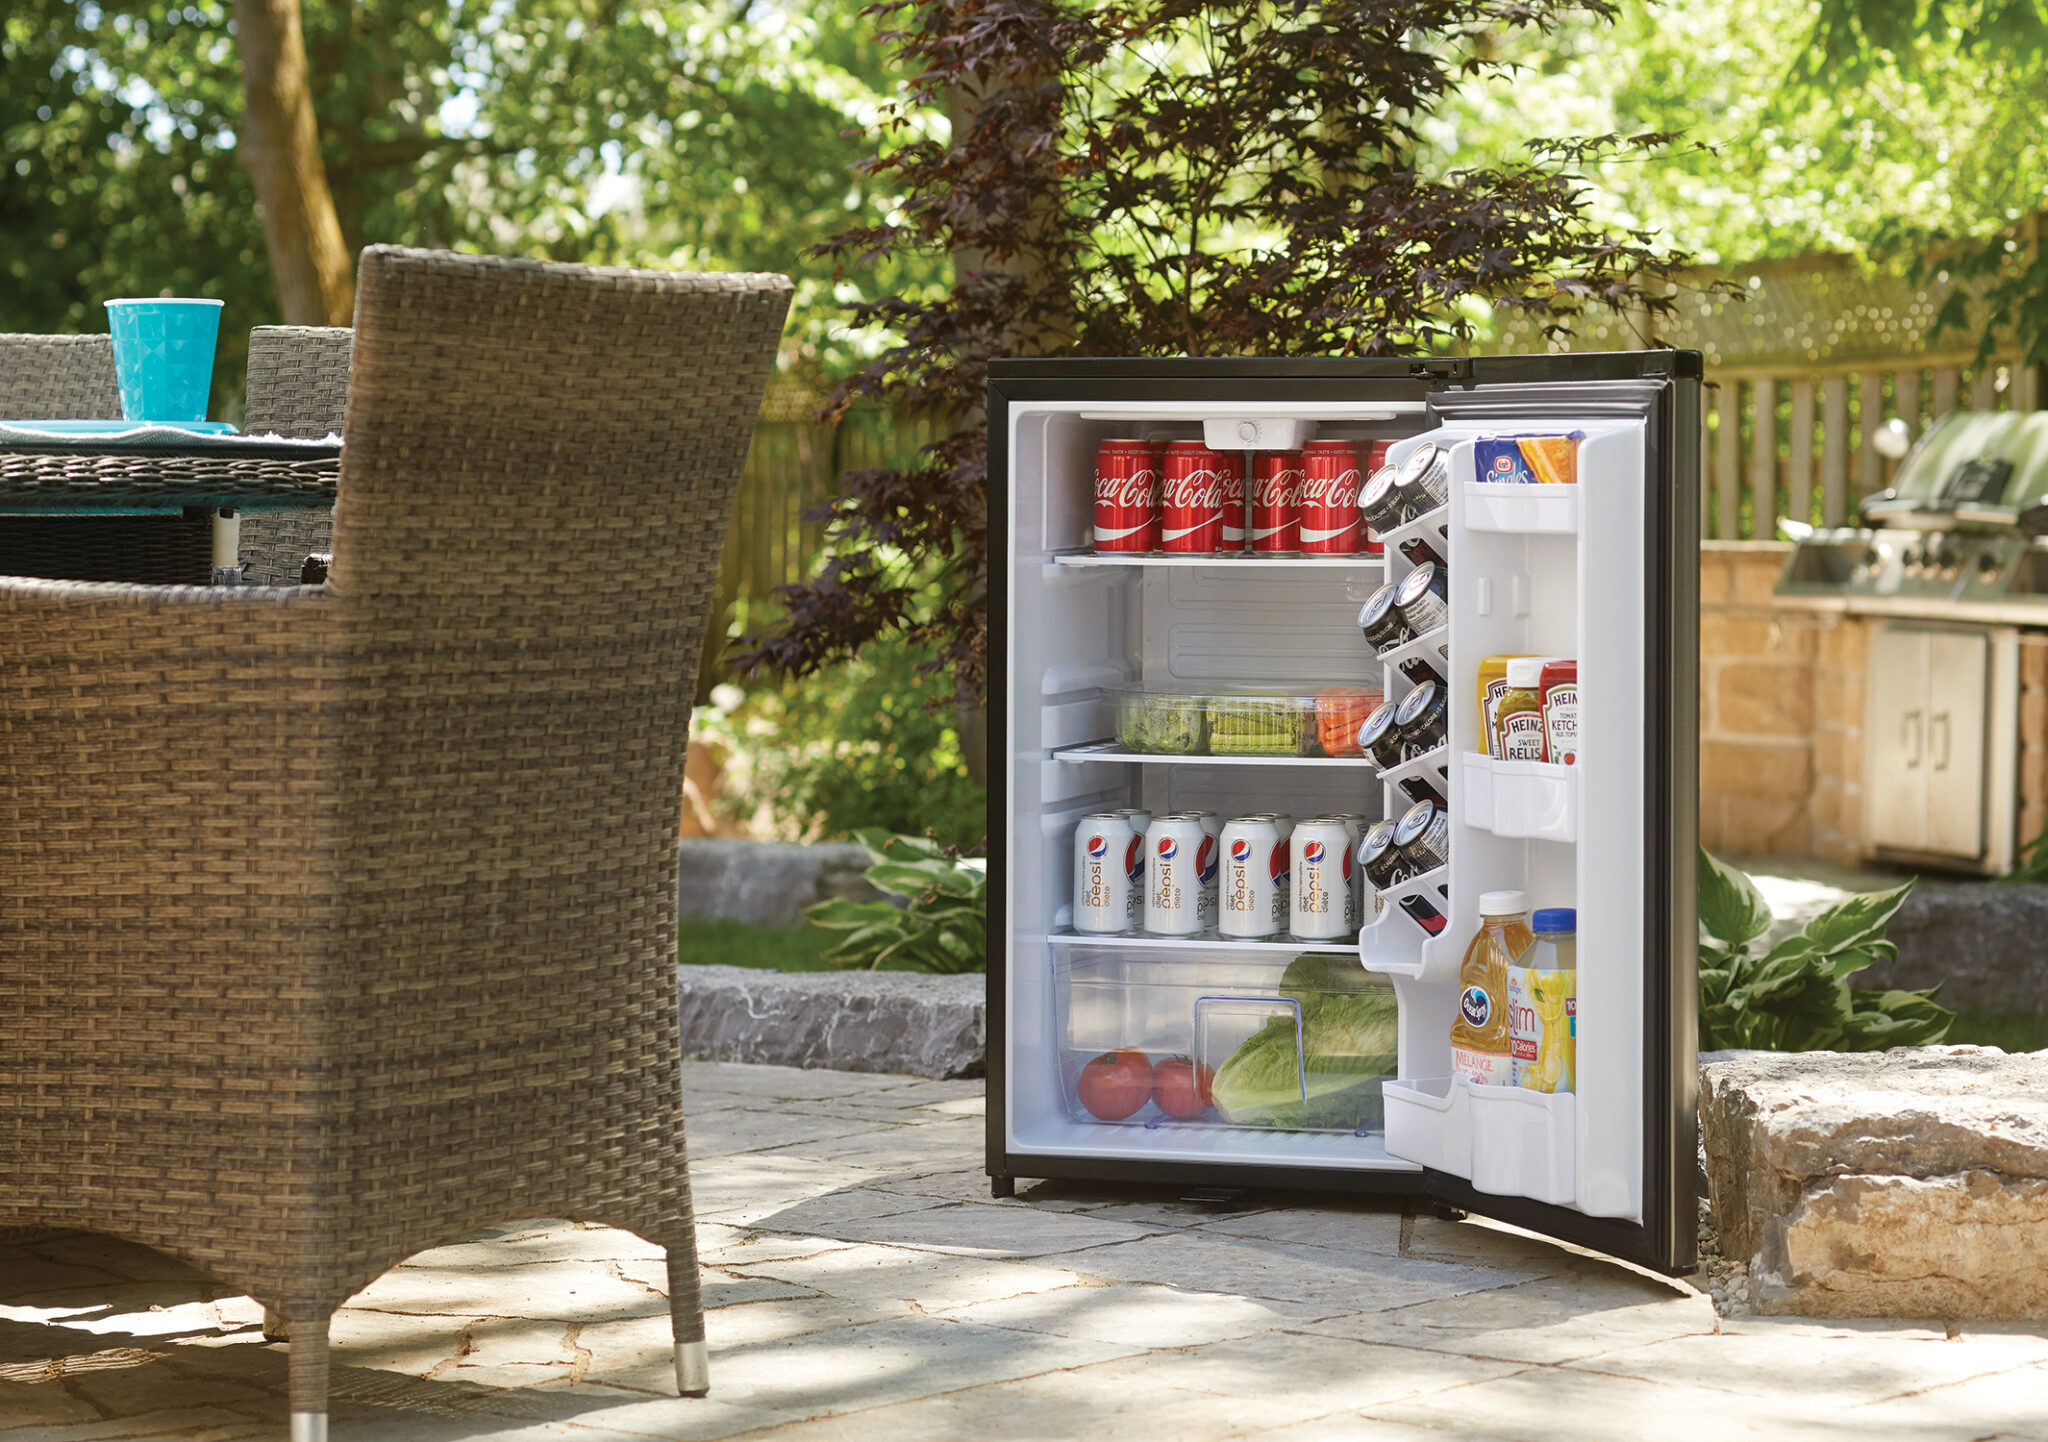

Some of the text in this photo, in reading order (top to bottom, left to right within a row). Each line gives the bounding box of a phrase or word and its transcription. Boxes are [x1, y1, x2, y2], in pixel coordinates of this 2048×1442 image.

[1094, 468, 1156, 508] oca-Col
[1301, 468, 1362, 508] oca-Col
[1553, 692, 1577, 707] HEIN
[1560, 712, 1577, 720] TOMAT
[1518, 738, 1540, 748] SWEET
[1551, 720, 1577, 732] KETCH
[1509, 747, 1541, 760] RELIS
[1089, 862, 1104, 908] pepsi
[1159, 863, 1175, 910] pepsi
[1233, 865, 1249, 911] pepsi
[1306, 867, 1322, 913] pepsi
[1509, 998, 1535, 1036] slim
[1516, 1040, 1536, 1054] Calories
